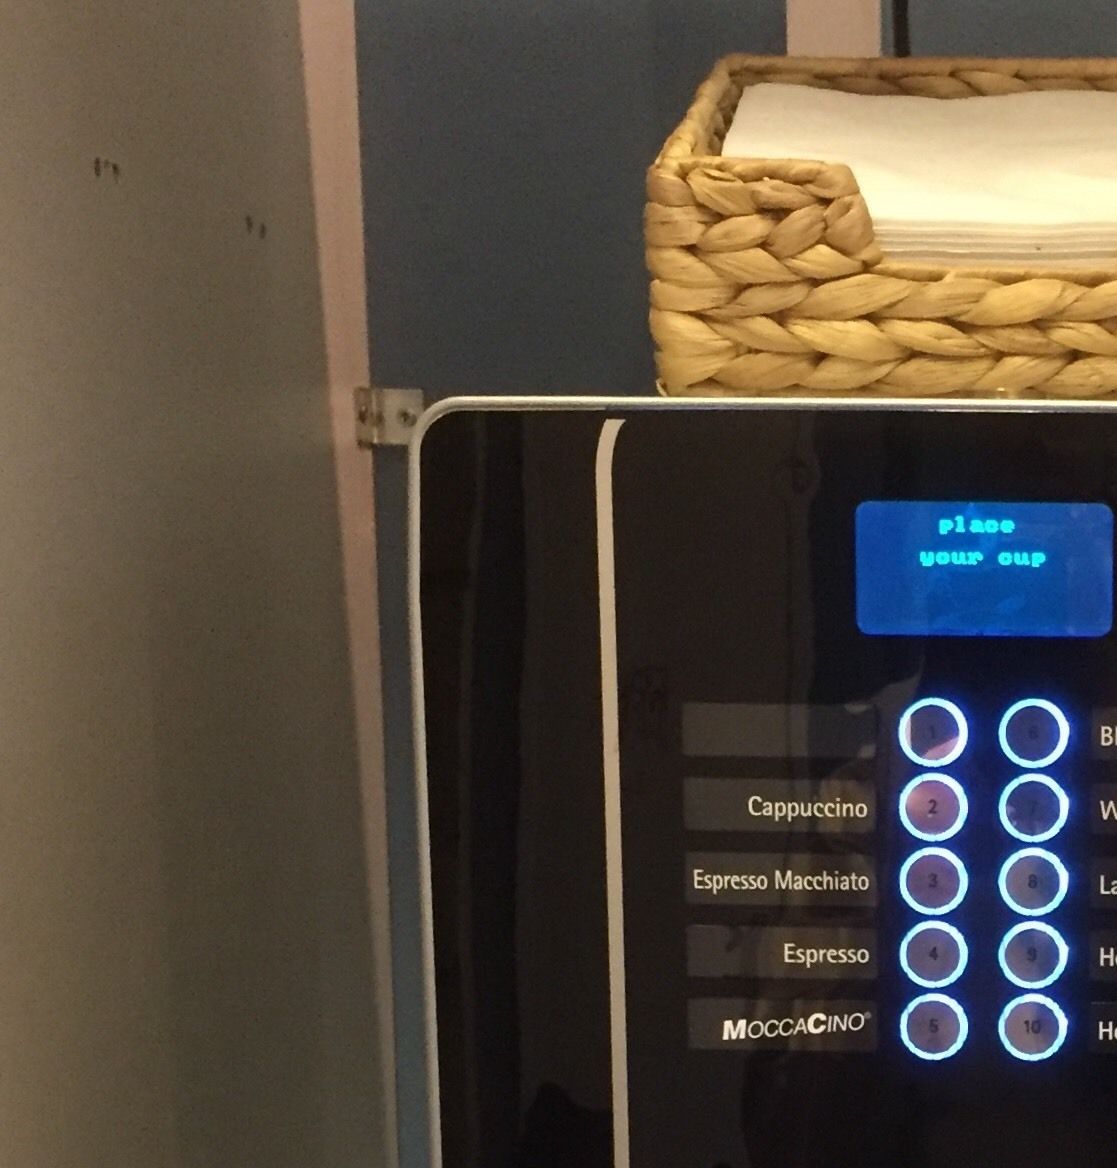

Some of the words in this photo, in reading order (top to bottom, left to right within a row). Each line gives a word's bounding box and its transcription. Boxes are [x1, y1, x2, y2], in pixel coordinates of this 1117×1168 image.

[938, 515, 1015, 535] place
[919, 551, 984, 567] your
[998, 551, 1046, 568] cup
[748, 795, 868, 822] Cappuccino
[928, 798, 938, 814] 2
[693, 869, 768, 895] Espresso
[774, 870, 870, 891] Macchiato
[928, 873, 938, 888] 3
[1027, 874, 1038, 889] 8
[783, 943, 870, 968] Espresso
[929, 947, 938, 961] 4
[1027, 947, 1037, 962] 9
[929, 1019, 939, 1033] 5
[1024, 1019, 1041, 1034] 10
